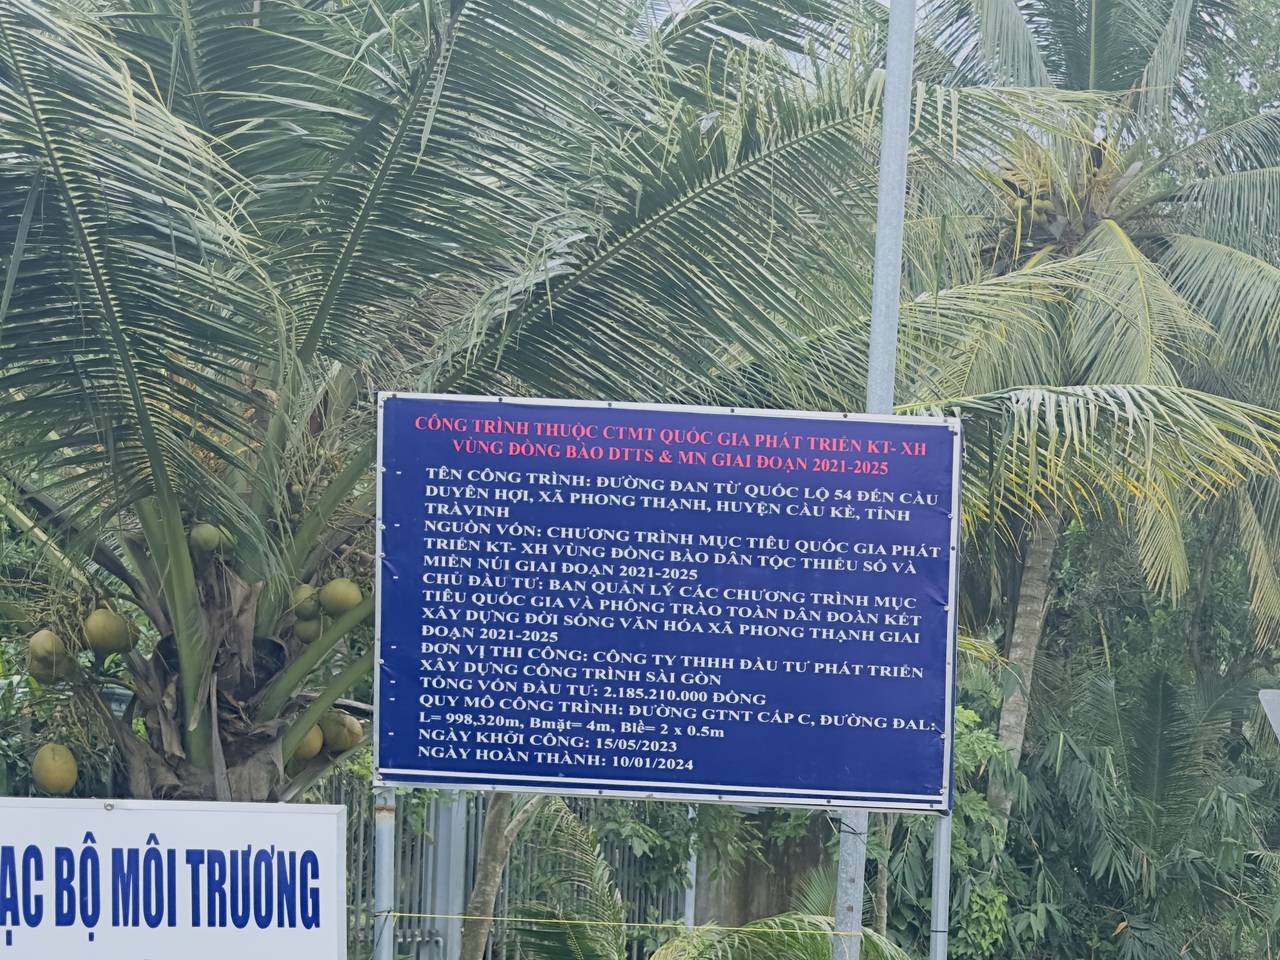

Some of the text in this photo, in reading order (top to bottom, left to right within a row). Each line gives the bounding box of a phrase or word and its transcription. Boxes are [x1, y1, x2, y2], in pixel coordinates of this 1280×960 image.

[415, 414, 467, 432] CÔNG
[472, 417, 529, 435] TRÌNH
[534, 422, 598, 440] THUỘC
[603, 426, 655, 440] CTMT
[717, 432, 749, 447] GIA
[755, 432, 803, 449] PHÁT
[901, 442, 926, 456] XH
[452, 436, 503, 454] VÙNG
[566, 442, 603, 459] BÀO
[609, 447, 654, 462] DTTS
[659, 450, 673, 463] &
[678, 451, 707, 465] MN
[712, 453, 751, 467] GIAI
[757, 455, 807, 473] ĐOẠN
[813, 458, 888, 475] 2021-2025
[426, 465, 462, 480] TÊN
[467, 467, 521, 483] CÔNG
[526, 471, 591, 487] TRÌNH:
[596, 475, 665, 491] ĐƯỜNG
[670, 480, 708, 493] ĐAN
[713, 480, 738, 495] TỪ
[804, 487, 830, 502] LỘ
[834, 489, 852, 501] 54
[426, 484, 489, 499] DUYÊN
[539, 489, 564, 503] XÃ
[570, 492, 636, 507] PHONG
[640, 496, 712, 513] THẠNH,
[717, 500, 781, 517] HUYỆN
[831, 504, 860, 520] KÈ,
[865, 506, 910, 521] TỈNH
[521, 543, 547, 555] XH
[553, 542, 605, 558] VÙNG
[670, 548, 709, 563] BÀO
[714, 551, 752, 566] DÂN
[757, 555, 796, 570] TỘC
[892, 560, 917, 574] VÀ
[547, 526, 630, 542] CHƯƠNG
[634, 529, 693, 545] TRÌNH
[699, 535, 742, 550] MỤC
[746, 535, 790, 550] TIÊU
[854, 543, 887, 555] GIA
[892, 543, 941, 558] PHÁT
[478, 556, 510, 571] NÚI
[515, 560, 556, 573] GIAI
[562, 562, 614, 578] ĐOẠN
[619, 565, 698, 580] 2021-2025
[422, 588, 466, 603] TIÊU
[530, 596, 564, 608] GIA
[568, 595, 594, 610] VÀ
[600, 598, 665, 613] PHÔNG
[670, 601, 722, 616] TRÀO
[726, 604, 778, 619] TOÀN
[783, 607, 821, 621] DÂN
[827, 609, 878, 624] ĐOÀN
[423, 571, 463, 586] CHỦ
[511, 577, 543, 590] TƯ:
[549, 579, 586, 592] BAN
[591, 580, 644, 595] QUẢN
[650, 582, 674, 597] LÝ
[679, 584, 719, 599] CÁC
[723, 588, 805, 603] CHƯƠNG
[810, 591, 868, 607] TRÌNH
[874, 596, 917, 611] MỤC
[422, 605, 461, 620] XÂY
[466, 609, 519, 625] DỰNG
[525, 611, 558, 625] ĐỜI
[620, 616, 658, 630] VĂN
[664, 618, 704, 633] HÓA
[708, 621, 734, 635] XÃ
[739, 624, 804, 638] PHONG
[809, 627, 874, 643] THẠNH
[880, 631, 919, 644] GIAI
[422, 625, 558, 643] ĐOẠN 2021-2025
[420, 657, 721, 686] XÂY DỰNG CÔNG TRÌNH SÀI GÒN
[421, 642, 460, 655] ĐƠN
[466, 645, 485, 659] VỊ
[490, 646, 522, 658] THI
[528, 645, 588, 662] CÔNG:
[593, 649, 647, 665] CÔNG
[652, 654, 676, 666] TY
[680, 656, 734, 669] THHH
[783, 661, 807, 673] TƯ
[814, 661, 864, 675] PHÁT
[566, 684, 598, 697] TƯ:
[604, 686, 708, 702] 2.185.210.000
[419, 694, 459, 708] QUY
[464, 694, 495, 709] MÔ
[499, 696, 554, 712] CÔNG
[558, 699, 623, 716] TRÌNH:
[629, 703, 697, 719] ĐƯỜNG
[702, 709, 753, 722] GTNT
[798, 714, 815, 727] C,
[820, 713, 887, 728] ĐƯỜNG
[893, 718, 936, 731] ĐAL:
[446, 713, 524, 729] 998,320m,
[586, 720, 615, 733] 4m,
[660, 724, 668, 735] 2
[674, 727, 682, 735] x
[687, 725, 724, 738] 0.5m
[419, 727, 677, 752] NGÀY KHỞI CÔNG: 15/05/2023
[418, 744, 694, 770] NGÀY HOÀN THÀNH: 10/01/2024
[55, 831, 100, 942] BỘ
[112, 832, 176, 928] MÔI
